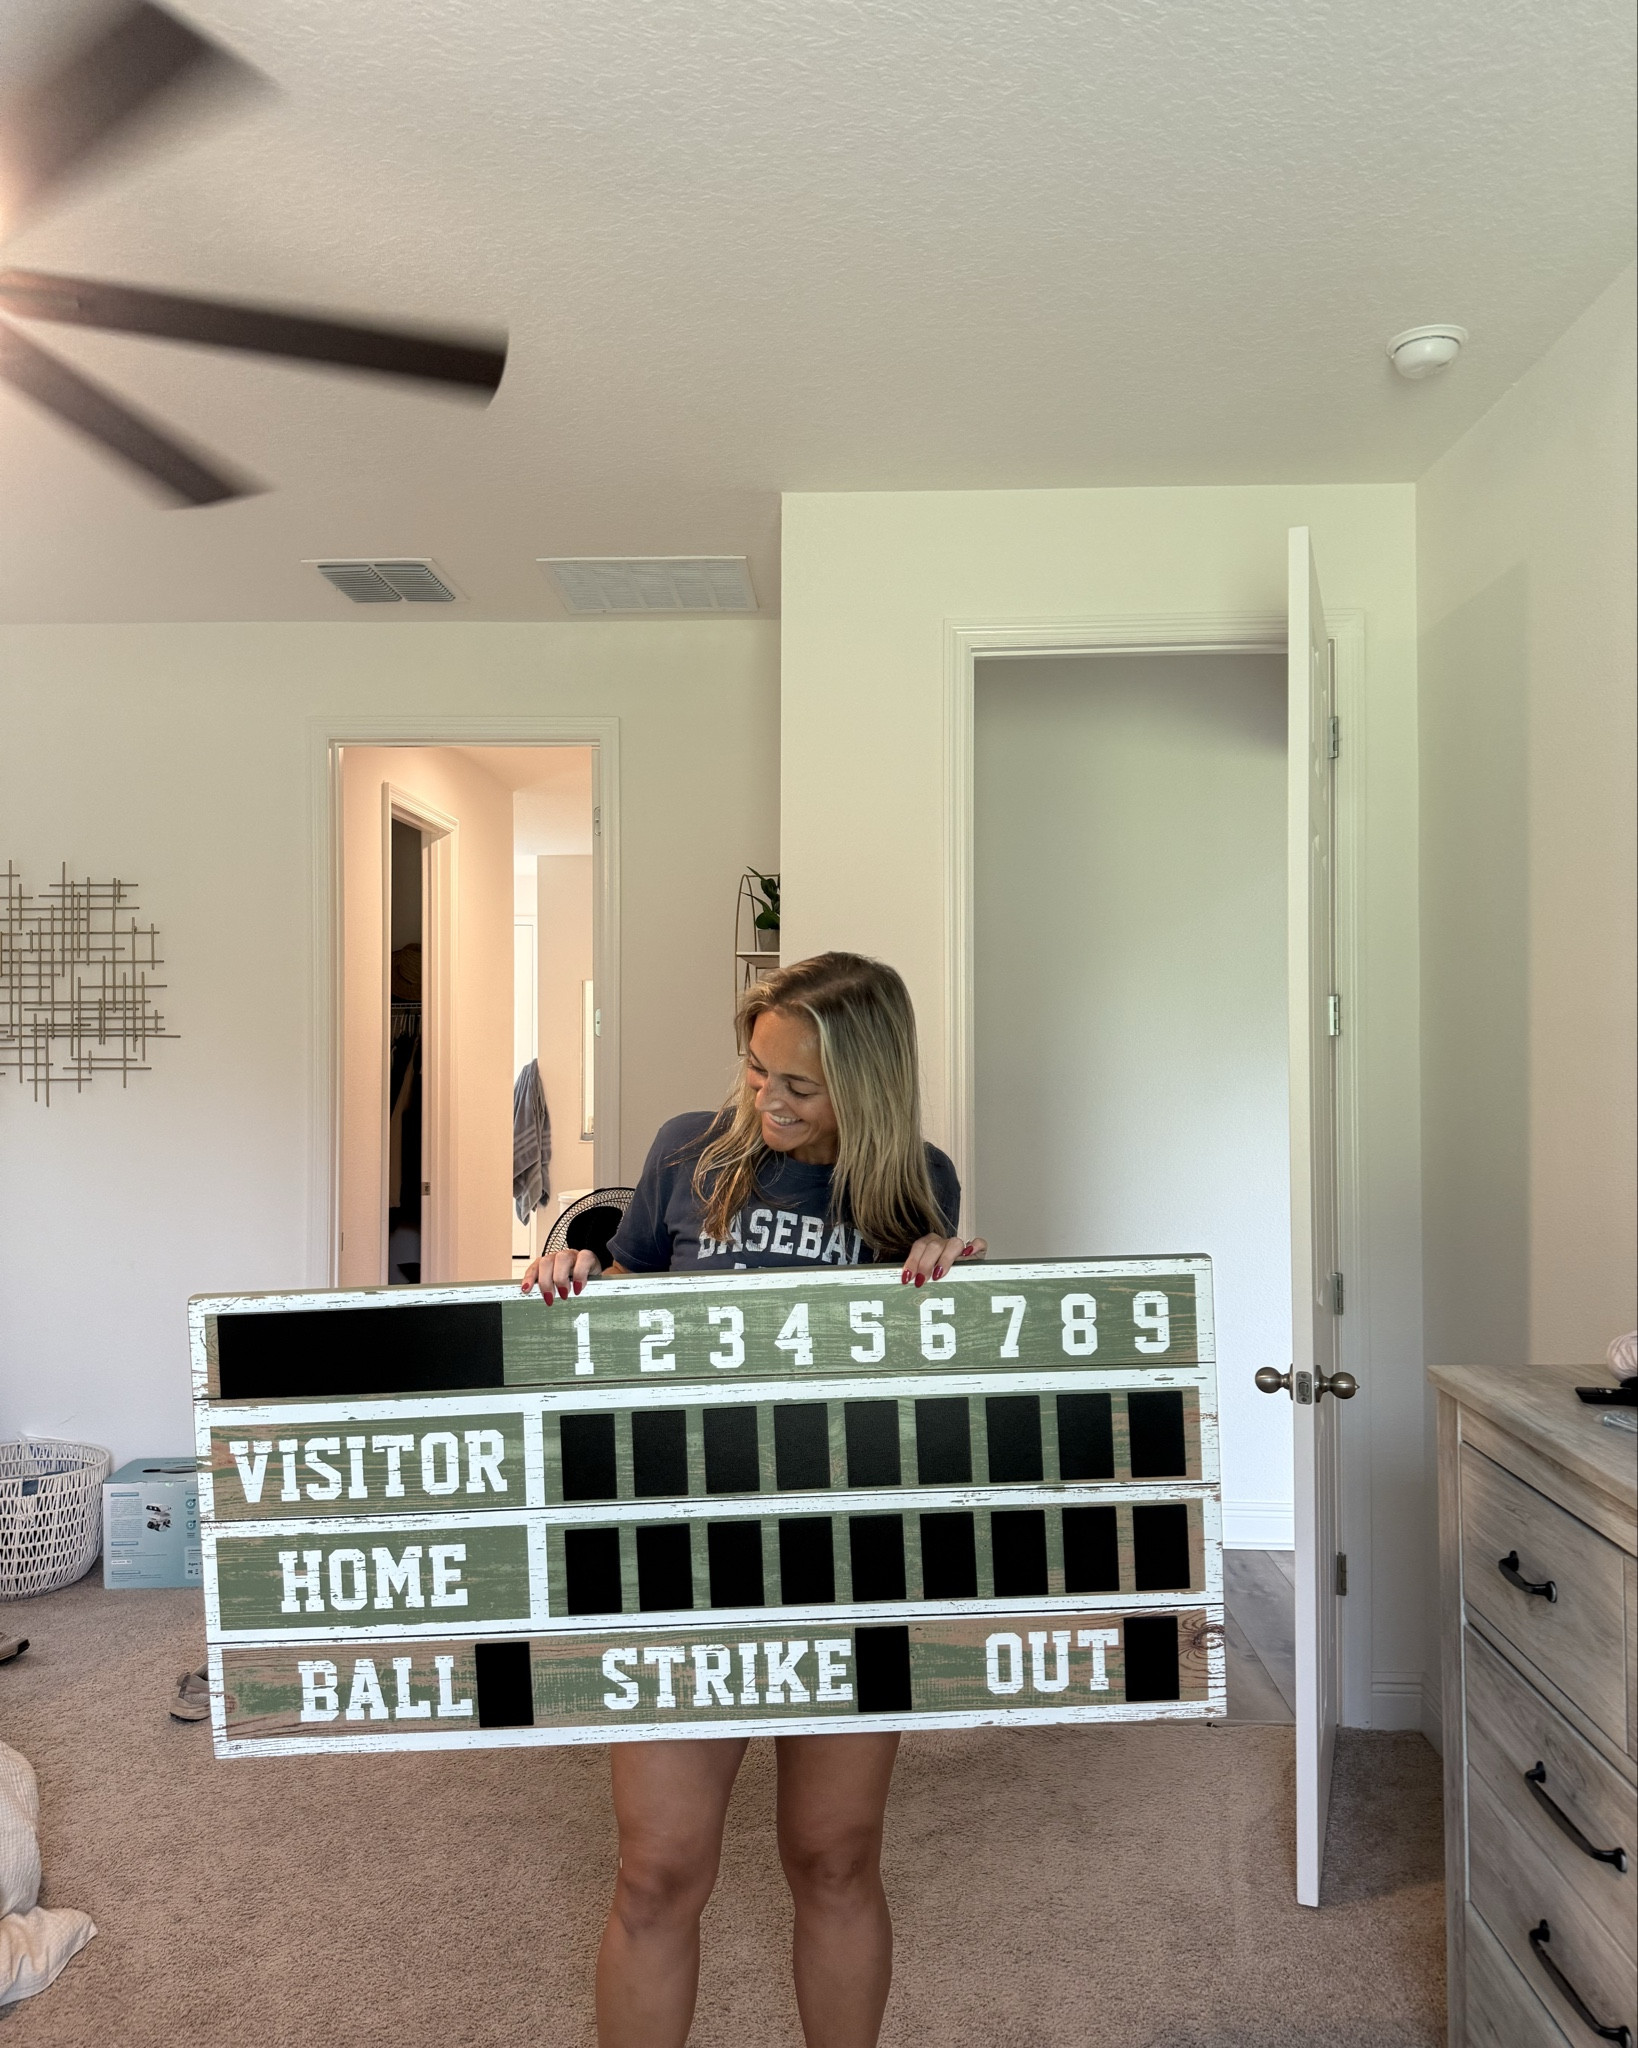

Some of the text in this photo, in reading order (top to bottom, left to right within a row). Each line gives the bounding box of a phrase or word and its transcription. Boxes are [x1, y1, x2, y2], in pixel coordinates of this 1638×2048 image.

[697, 1208, 867, 1265] BASEBAL
[573, 1290, 1171, 1376] 1 2 3 4 5 6 7 8 9
[229, 1429, 508, 1503] VISITOR
[278, 1543, 469, 1613] HOME
[297, 1628, 1120, 1722] BALL STRIKE OUT
